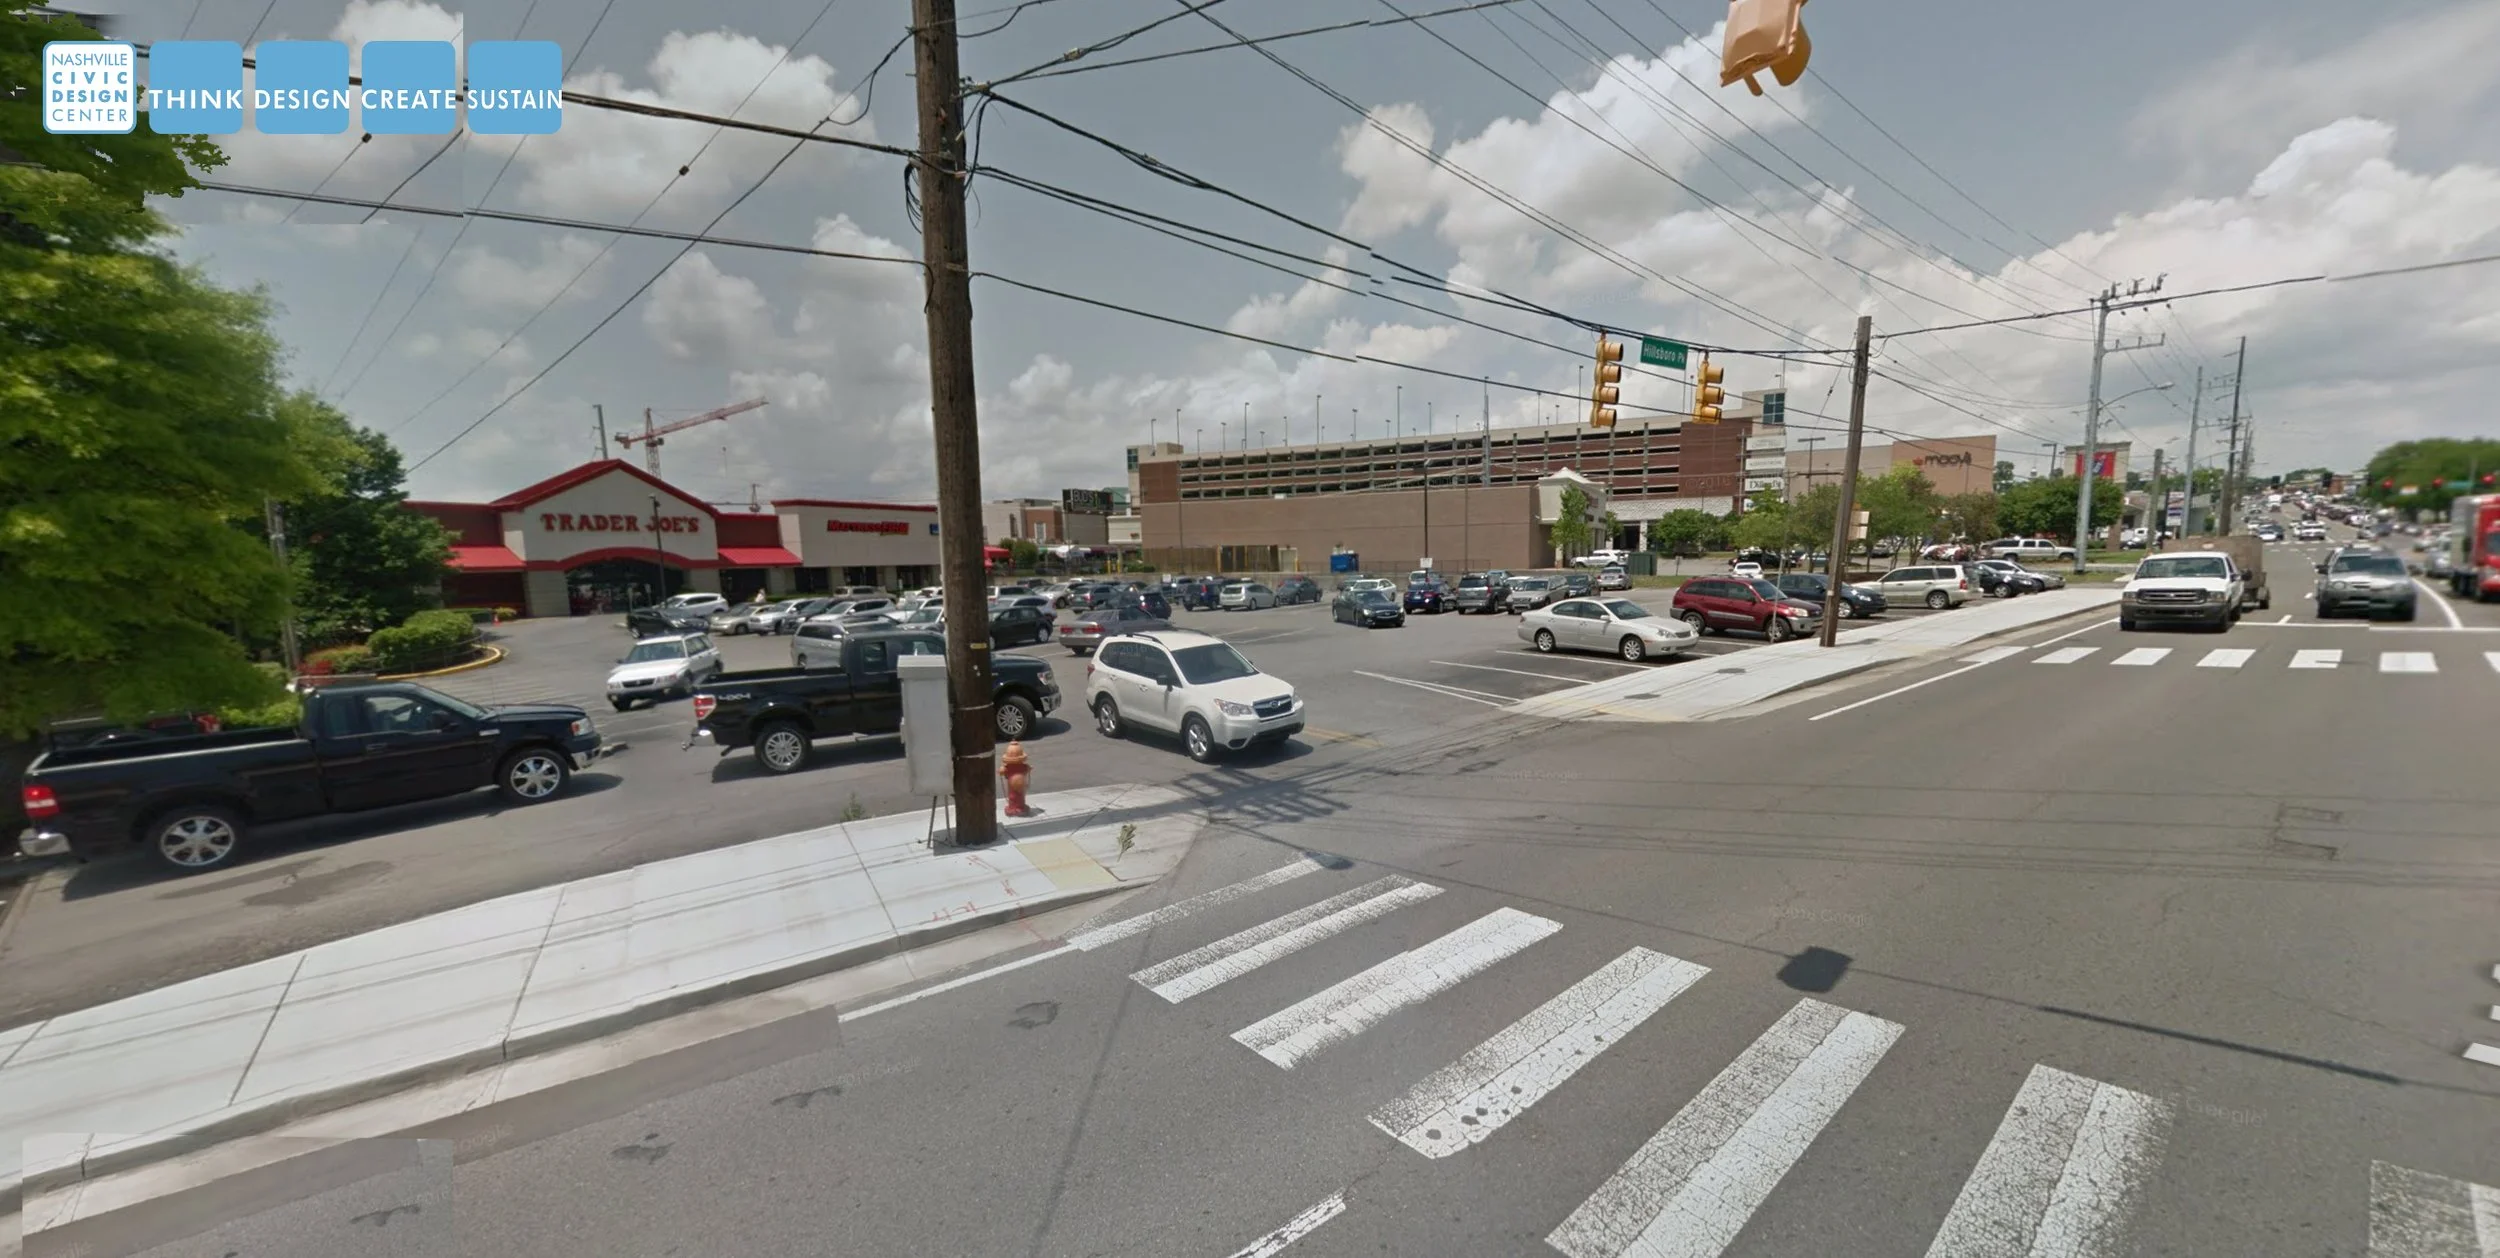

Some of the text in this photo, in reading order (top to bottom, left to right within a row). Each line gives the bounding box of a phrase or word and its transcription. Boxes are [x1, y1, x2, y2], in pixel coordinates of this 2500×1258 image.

[1642, 343, 1676, 362] Hillsboro
[540, 513, 699, 533] TRADER JOE'S
